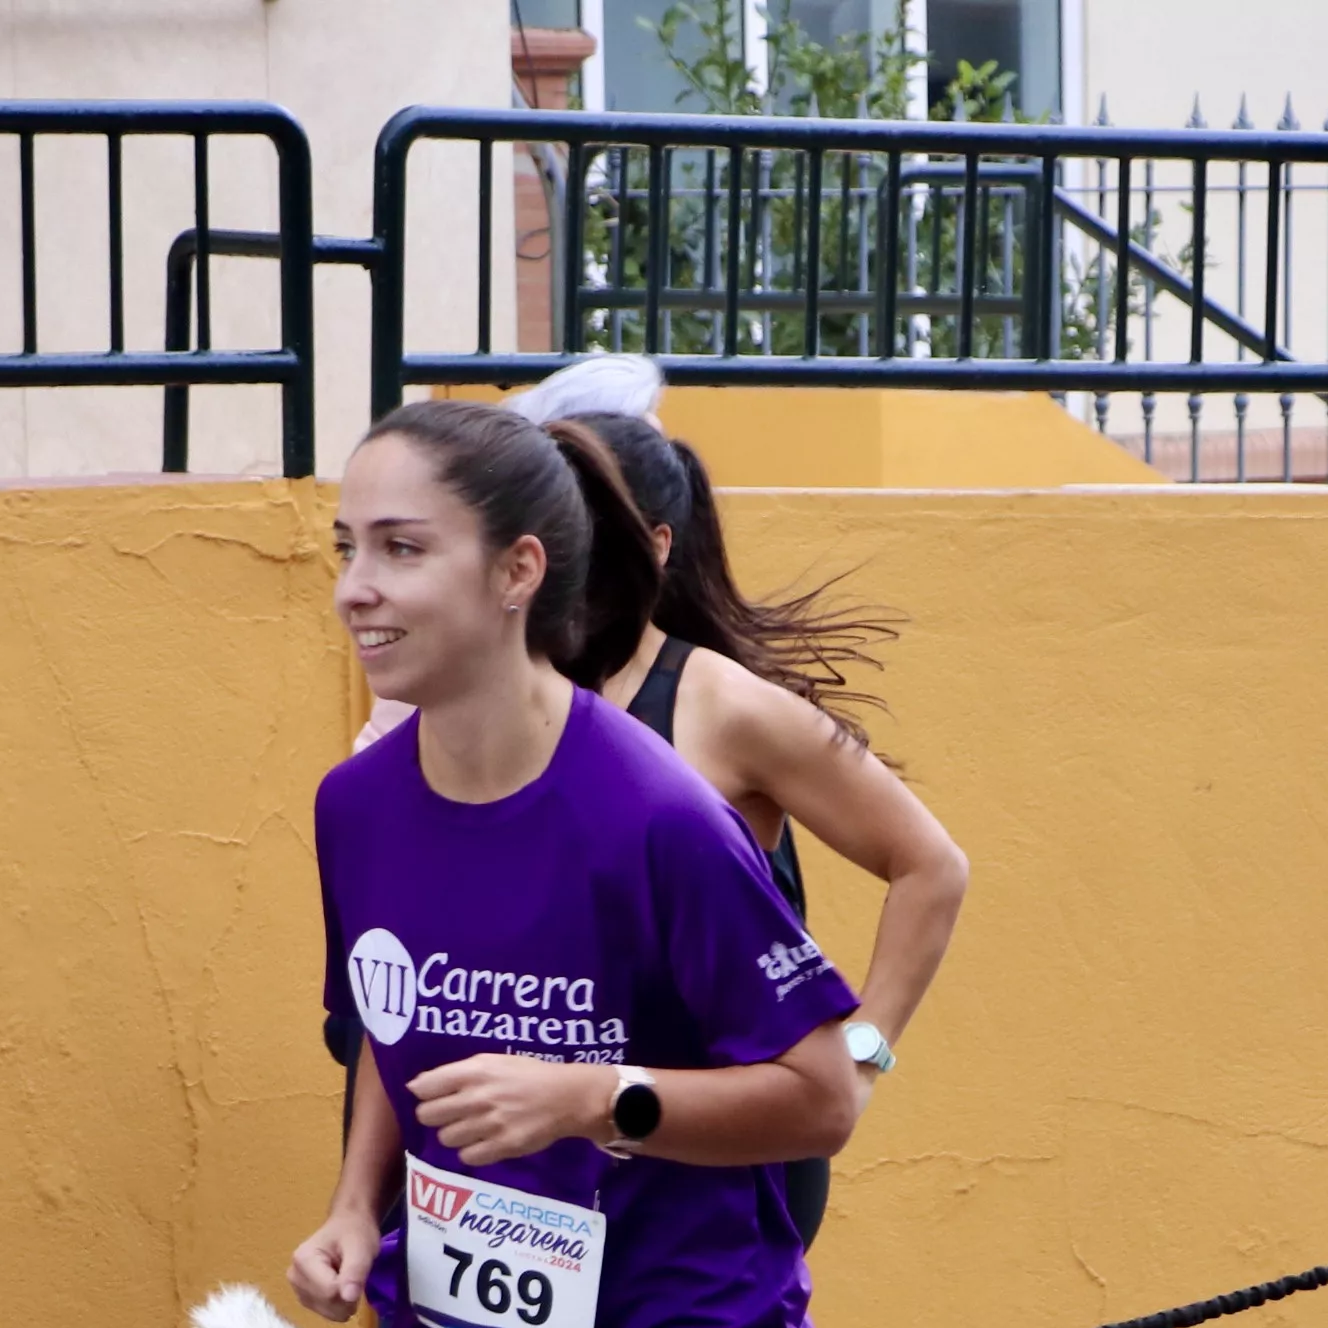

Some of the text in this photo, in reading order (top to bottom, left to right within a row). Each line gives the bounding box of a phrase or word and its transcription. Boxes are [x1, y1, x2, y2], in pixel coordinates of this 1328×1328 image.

[353, 956, 409, 1018] VII
[416, 952, 595, 1012] Carrera
[415, 1003, 630, 1046] nazarena
[573, 1048, 625, 1065] 2024
[413, 1174, 458, 1221] VII
[475, 1192, 593, 1237] CARRERA
[459, 1210, 590, 1261] nazarena
[443, 1243, 554, 1326] 769
[550, 1255, 581, 1272] 2024
